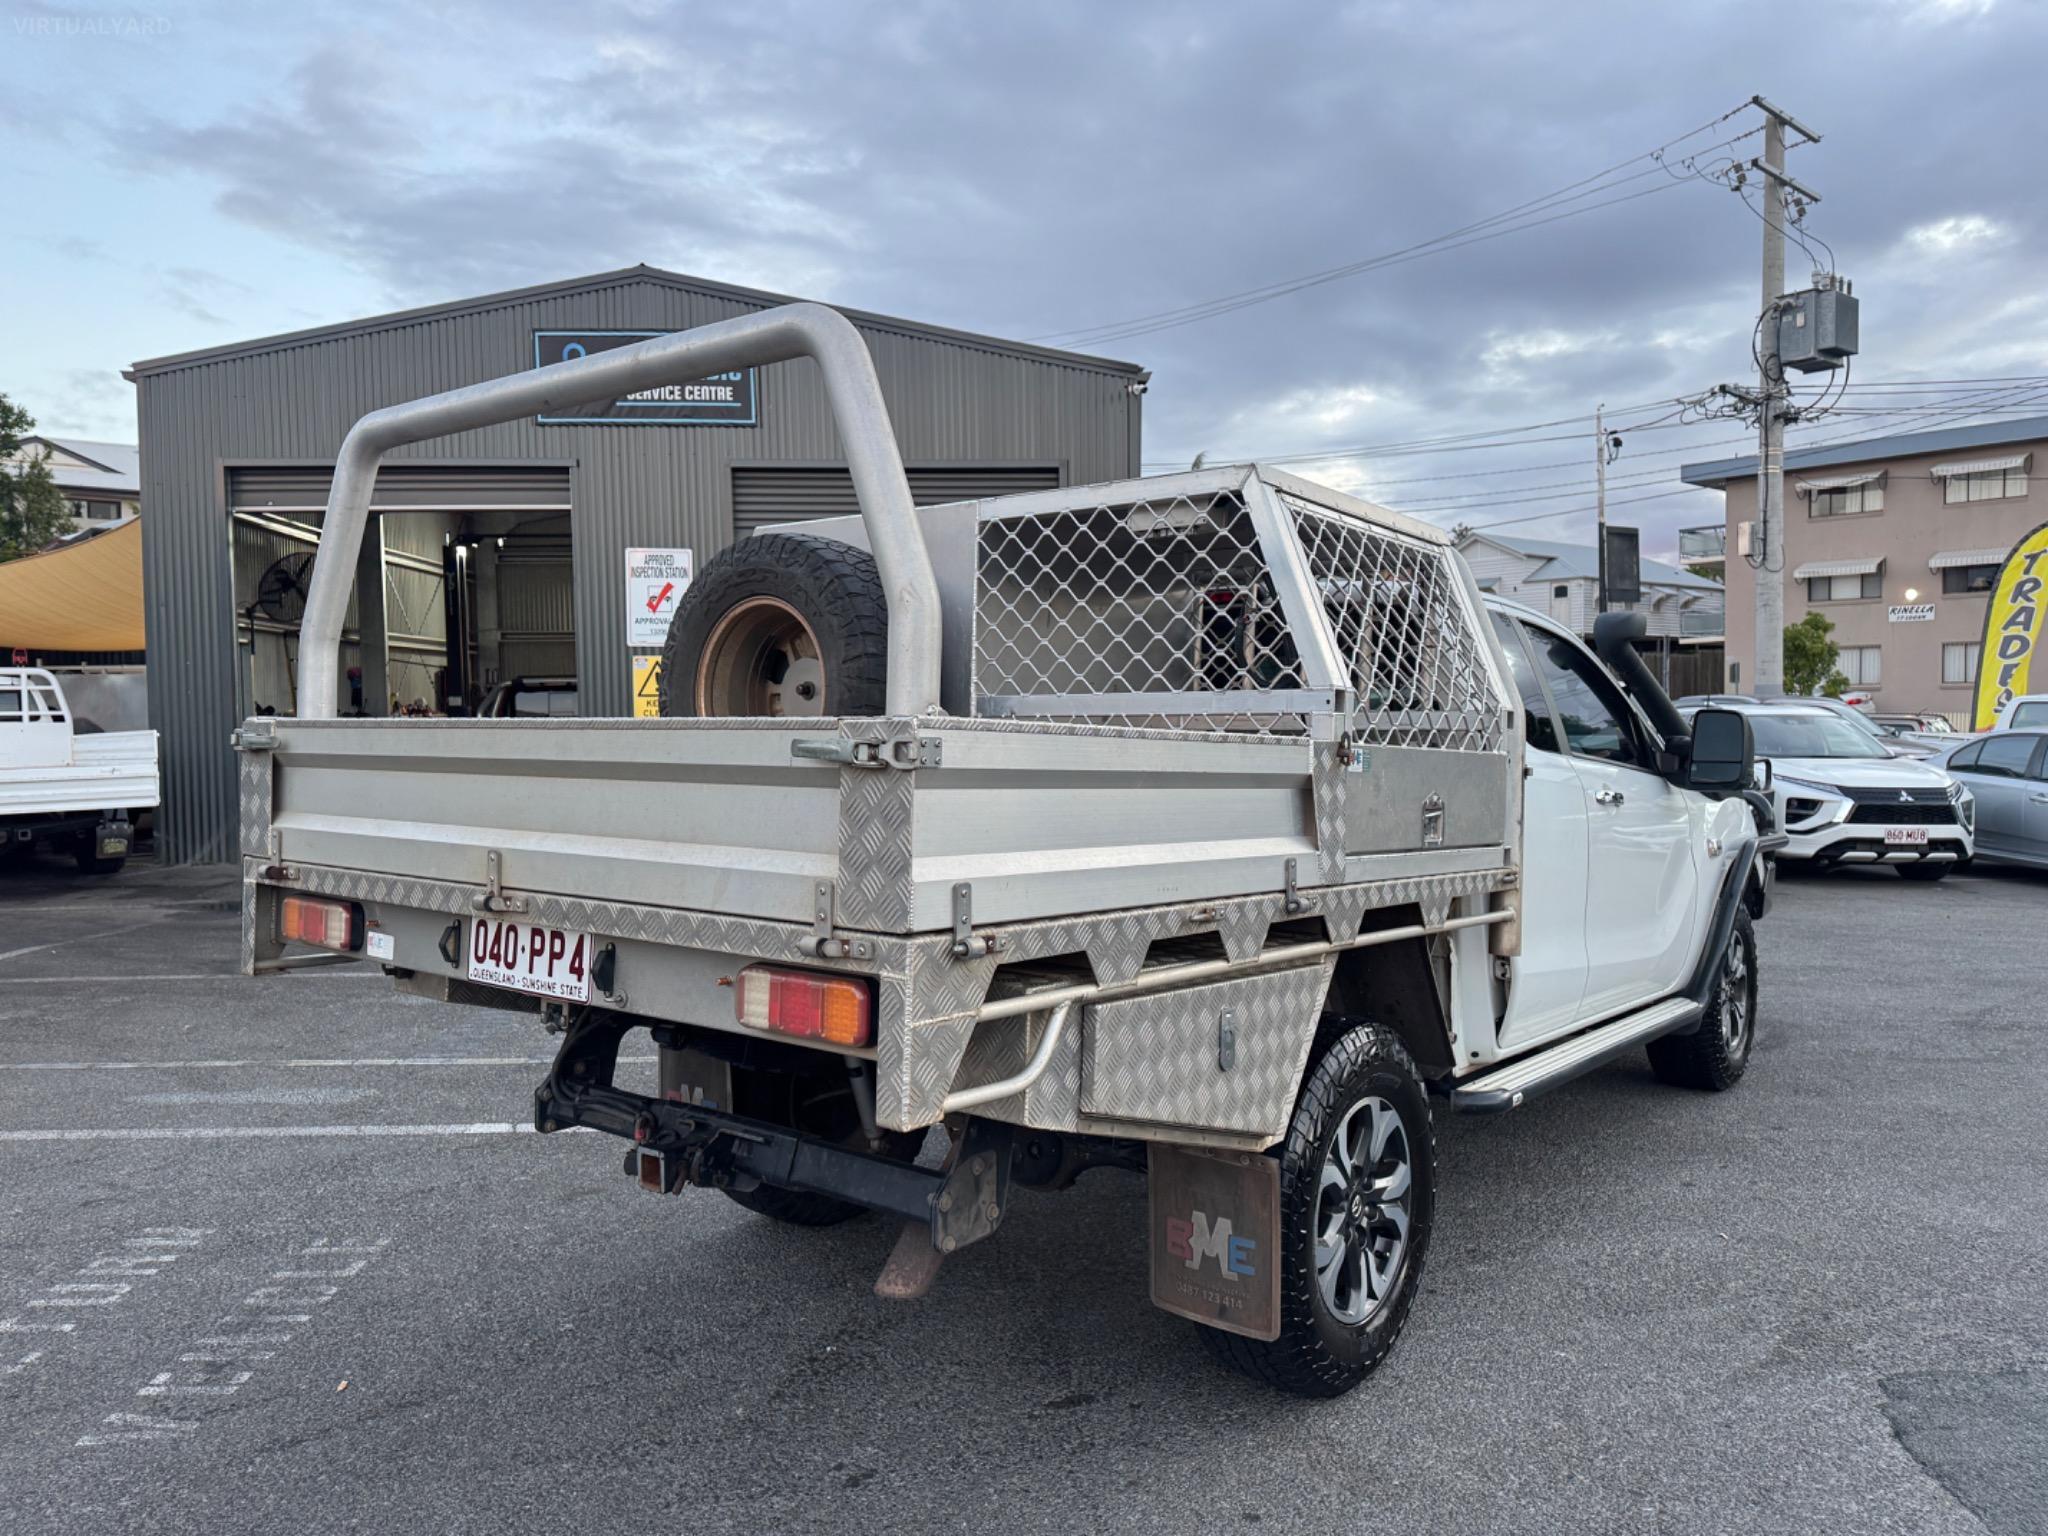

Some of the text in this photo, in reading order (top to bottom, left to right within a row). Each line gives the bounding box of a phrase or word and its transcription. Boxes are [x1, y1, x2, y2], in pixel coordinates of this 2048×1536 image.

[684, 386, 734, 401] CENTRE
[643, 554, 675, 566] APPROVED
[630, 566, 689, 579] INSPECTION STATION
[473, 967, 583, 999] QUEENSLAND SUNSHINE STATE
